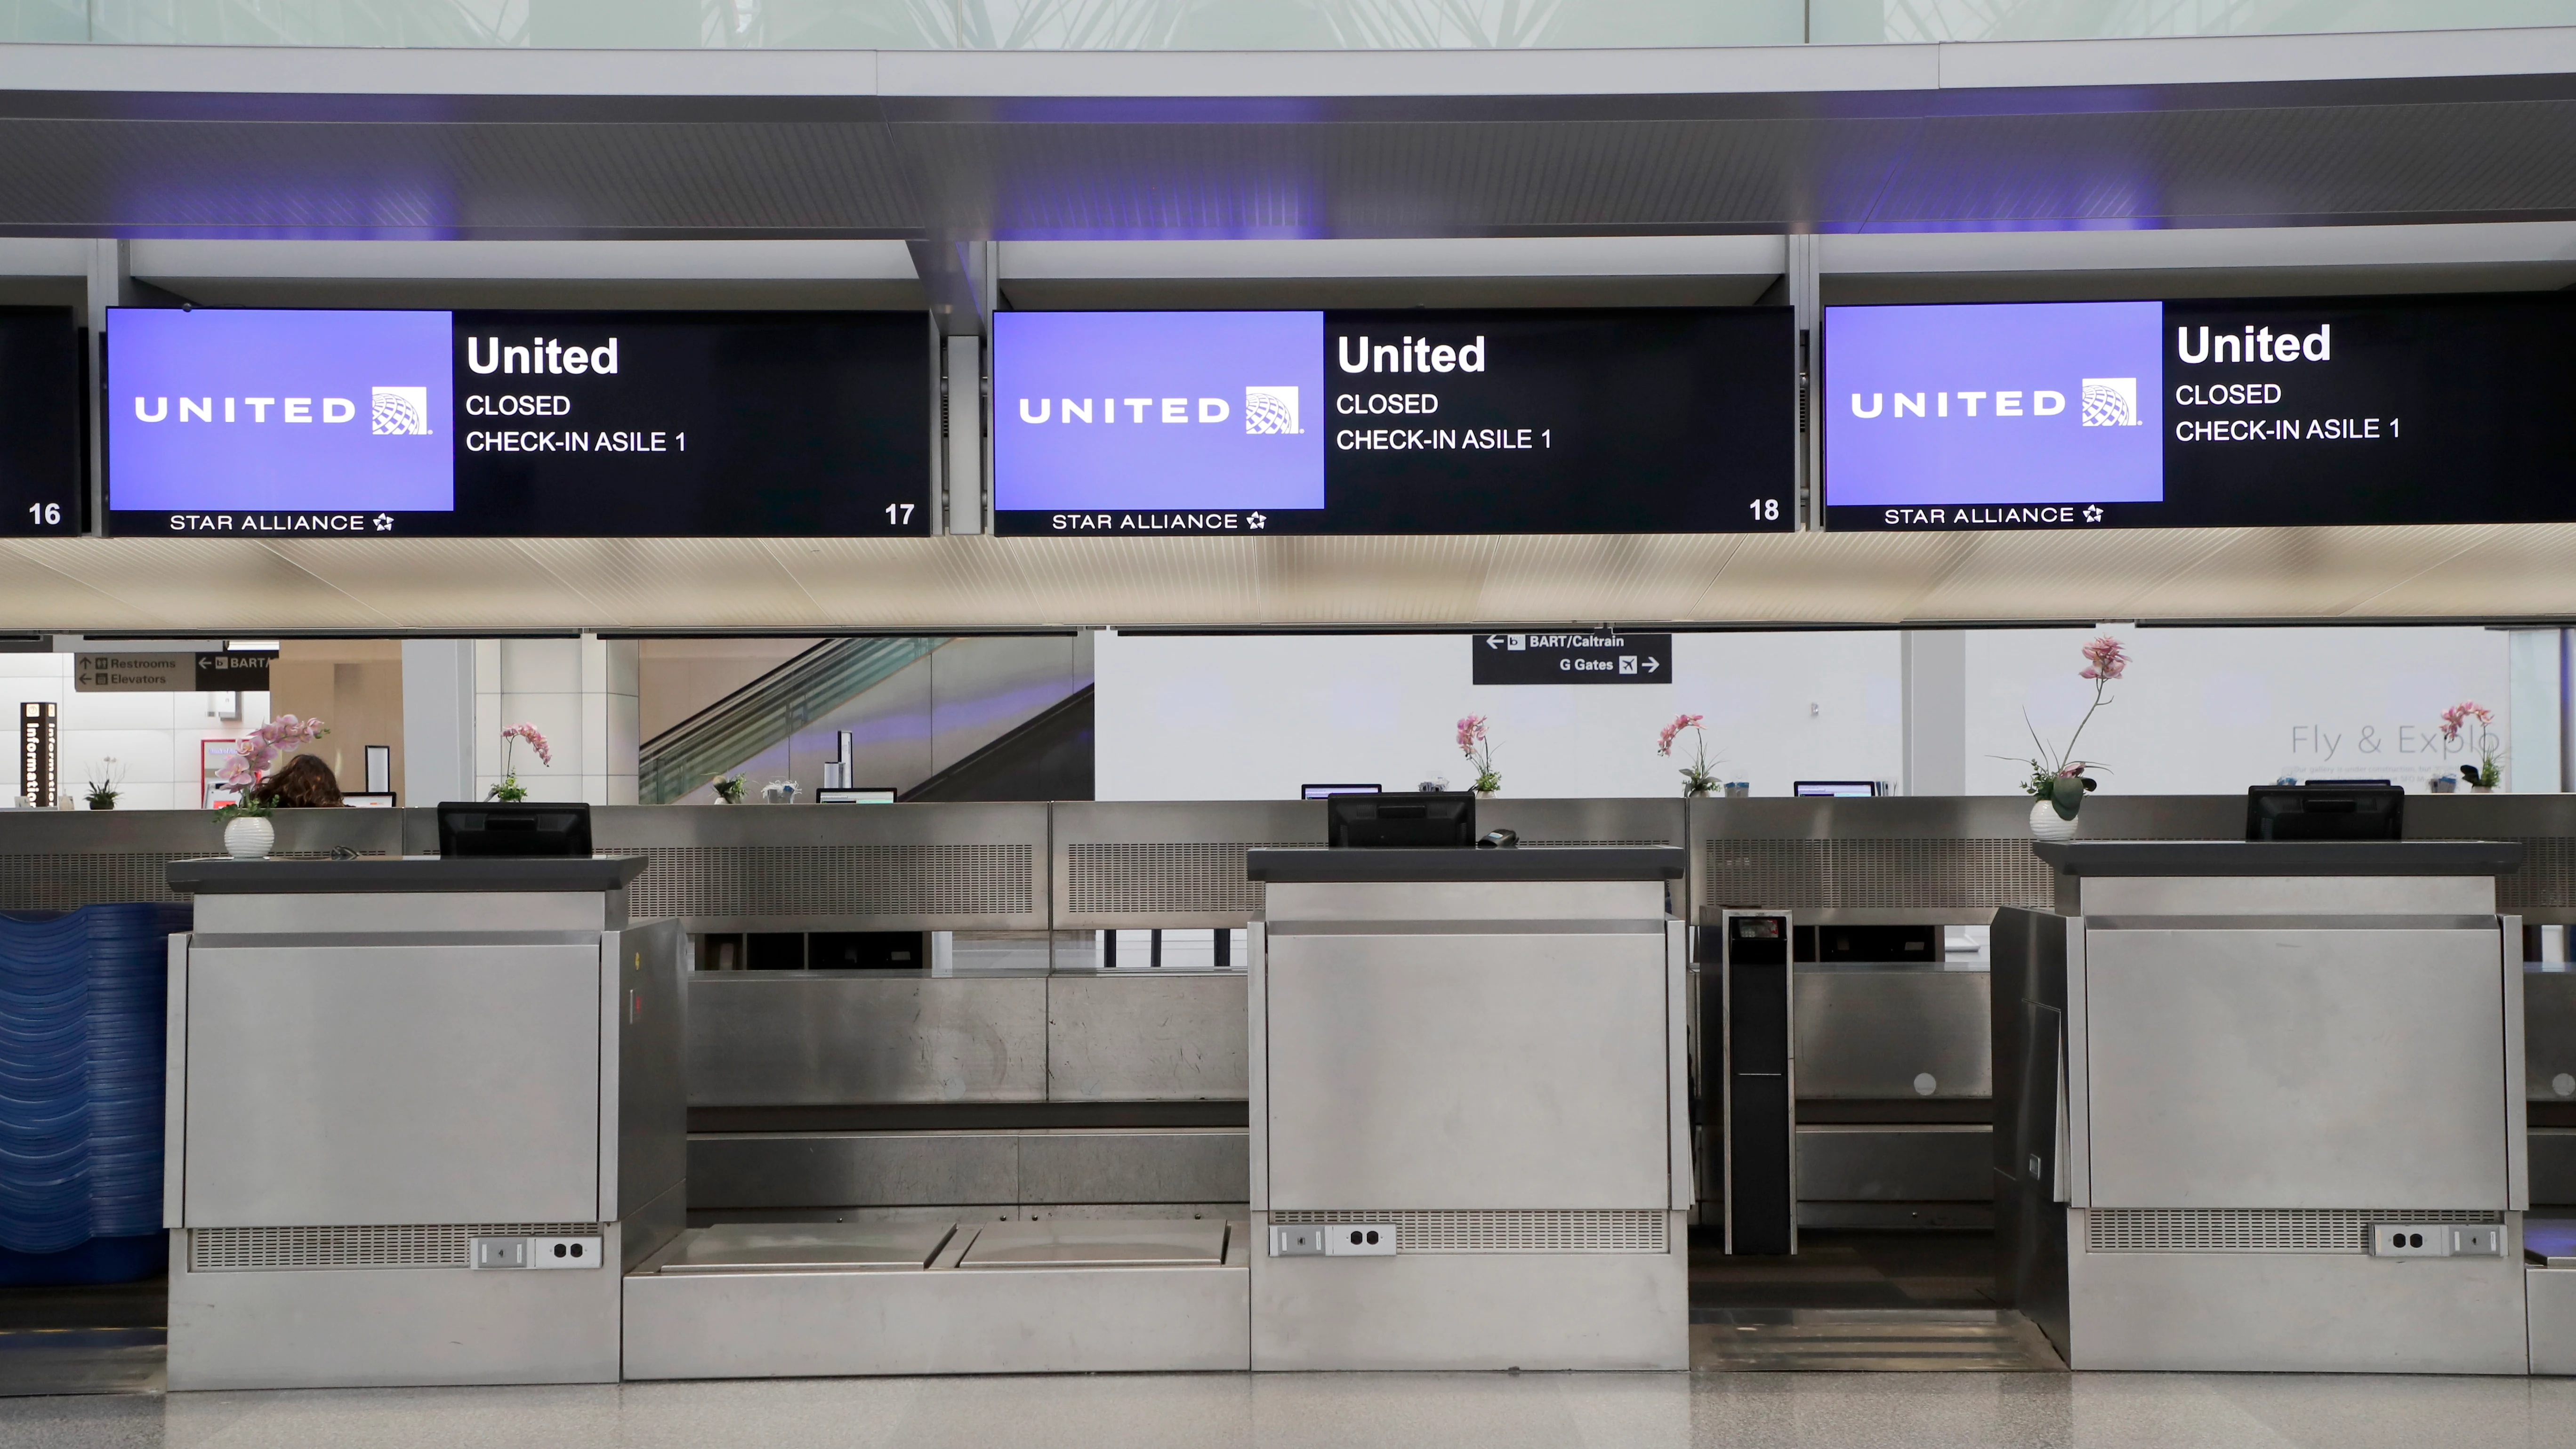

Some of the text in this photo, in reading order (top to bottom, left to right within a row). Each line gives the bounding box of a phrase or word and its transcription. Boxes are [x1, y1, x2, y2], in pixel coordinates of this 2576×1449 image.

[2178, 324, 2330, 363] United
[468, 337, 618, 374] United
[1339, 336, 1485, 373] United
[1336, 394, 1438, 414] CLOSED
[1852, 390, 2065, 419] UNITED
[2176, 384, 2281, 405] CLOSED
[135, 397, 355, 423] UNITED
[466, 395, 571, 416] CLOSED
[1020, 398, 1230, 424] UNITED
[1336, 429, 1550, 450] CHECK-IN ASILE 1
[2176, 418, 2399, 442] CHECK-IN ASILE 1
[466, 431, 684, 451] CHECK-IN ASILE 1
[29, 503, 60, 525] 16
[886, 503, 915, 525] 17
[1750, 499, 1779, 521] 18
[1884, 507, 2074, 524] STAR ALLIANCE
[170, 515, 364, 530] STAR ALLIANCE
[1053, 514, 1238, 529] STAR ALLIANCE
[1530, 636, 1624, 648] BART/Caltrain
[111, 659, 176, 668] Restrooms
[1560, 659, 1614, 670] G Gates
[111, 674, 166, 684] Elevators
[2293, 725, 2341, 761] Fly
[2359, 726, 2381, 752] &
[2310, 766, 2334, 774] gallery
